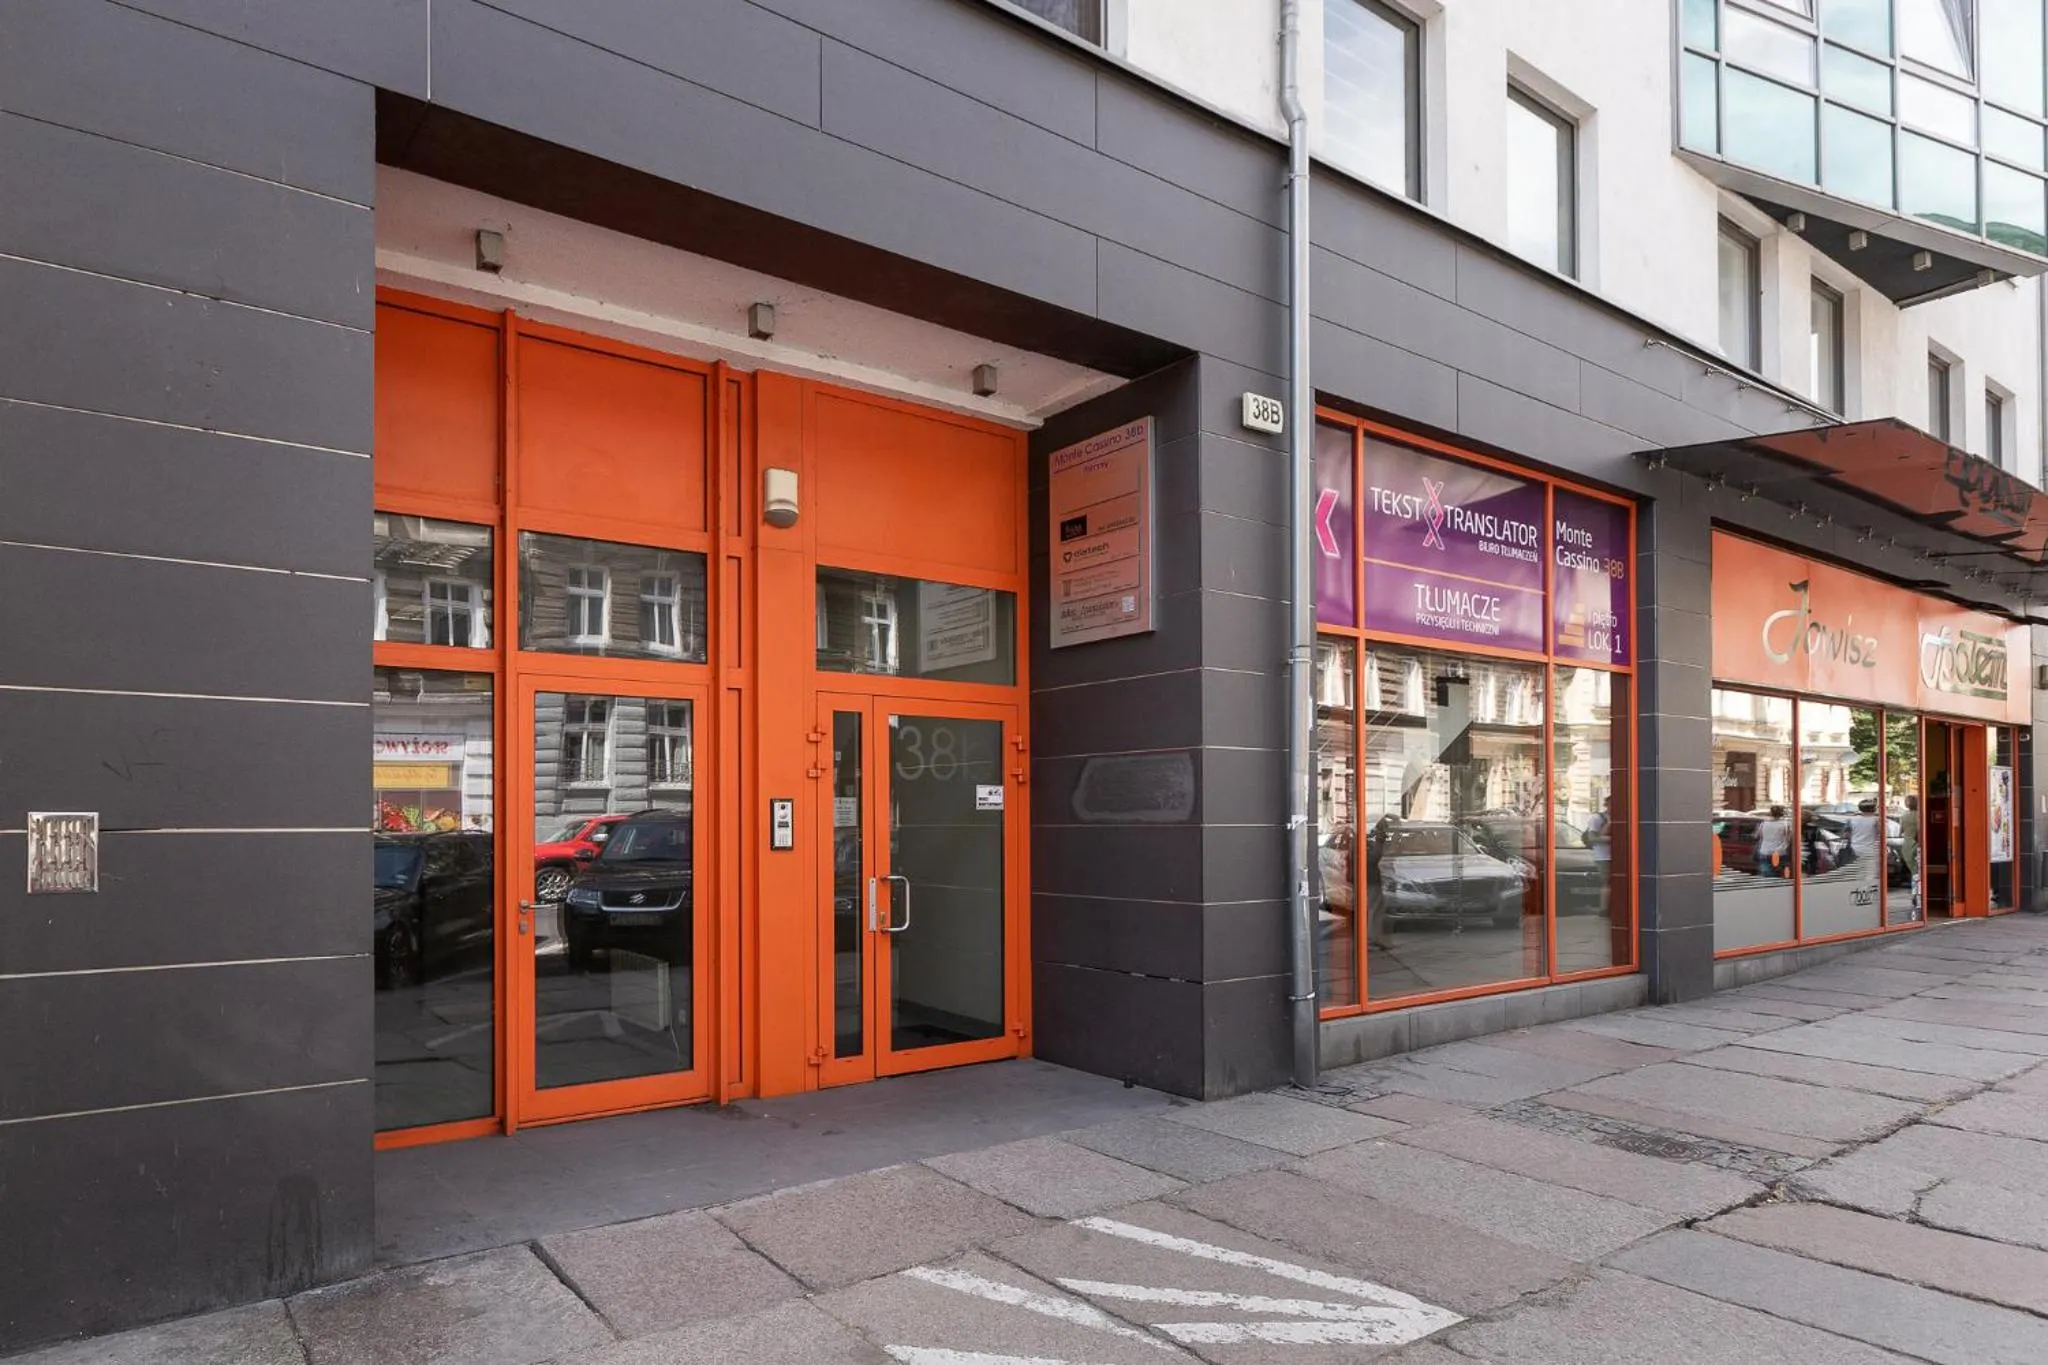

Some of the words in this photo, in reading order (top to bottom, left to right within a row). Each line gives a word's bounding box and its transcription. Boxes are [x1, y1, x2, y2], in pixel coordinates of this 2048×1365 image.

[1252, 396, 1281, 425] 38B
[1055, 448, 1083, 469] Monte
[1370, 487, 1422, 521] TEKST
[1444, 505, 1538, 548] TRANSLATOR
[1479, 540, 1500, 556] BIURO
[1555, 520, 1593, 548] Monte
[1555, 545, 1600, 573] Cassino
[1602, 558, 1625, 580] 38B
[1414, 583, 1502, 622] TŁUMACZE
[1762, 579, 1877, 668] Jowisz
[1614, 634, 1623, 654] 1
